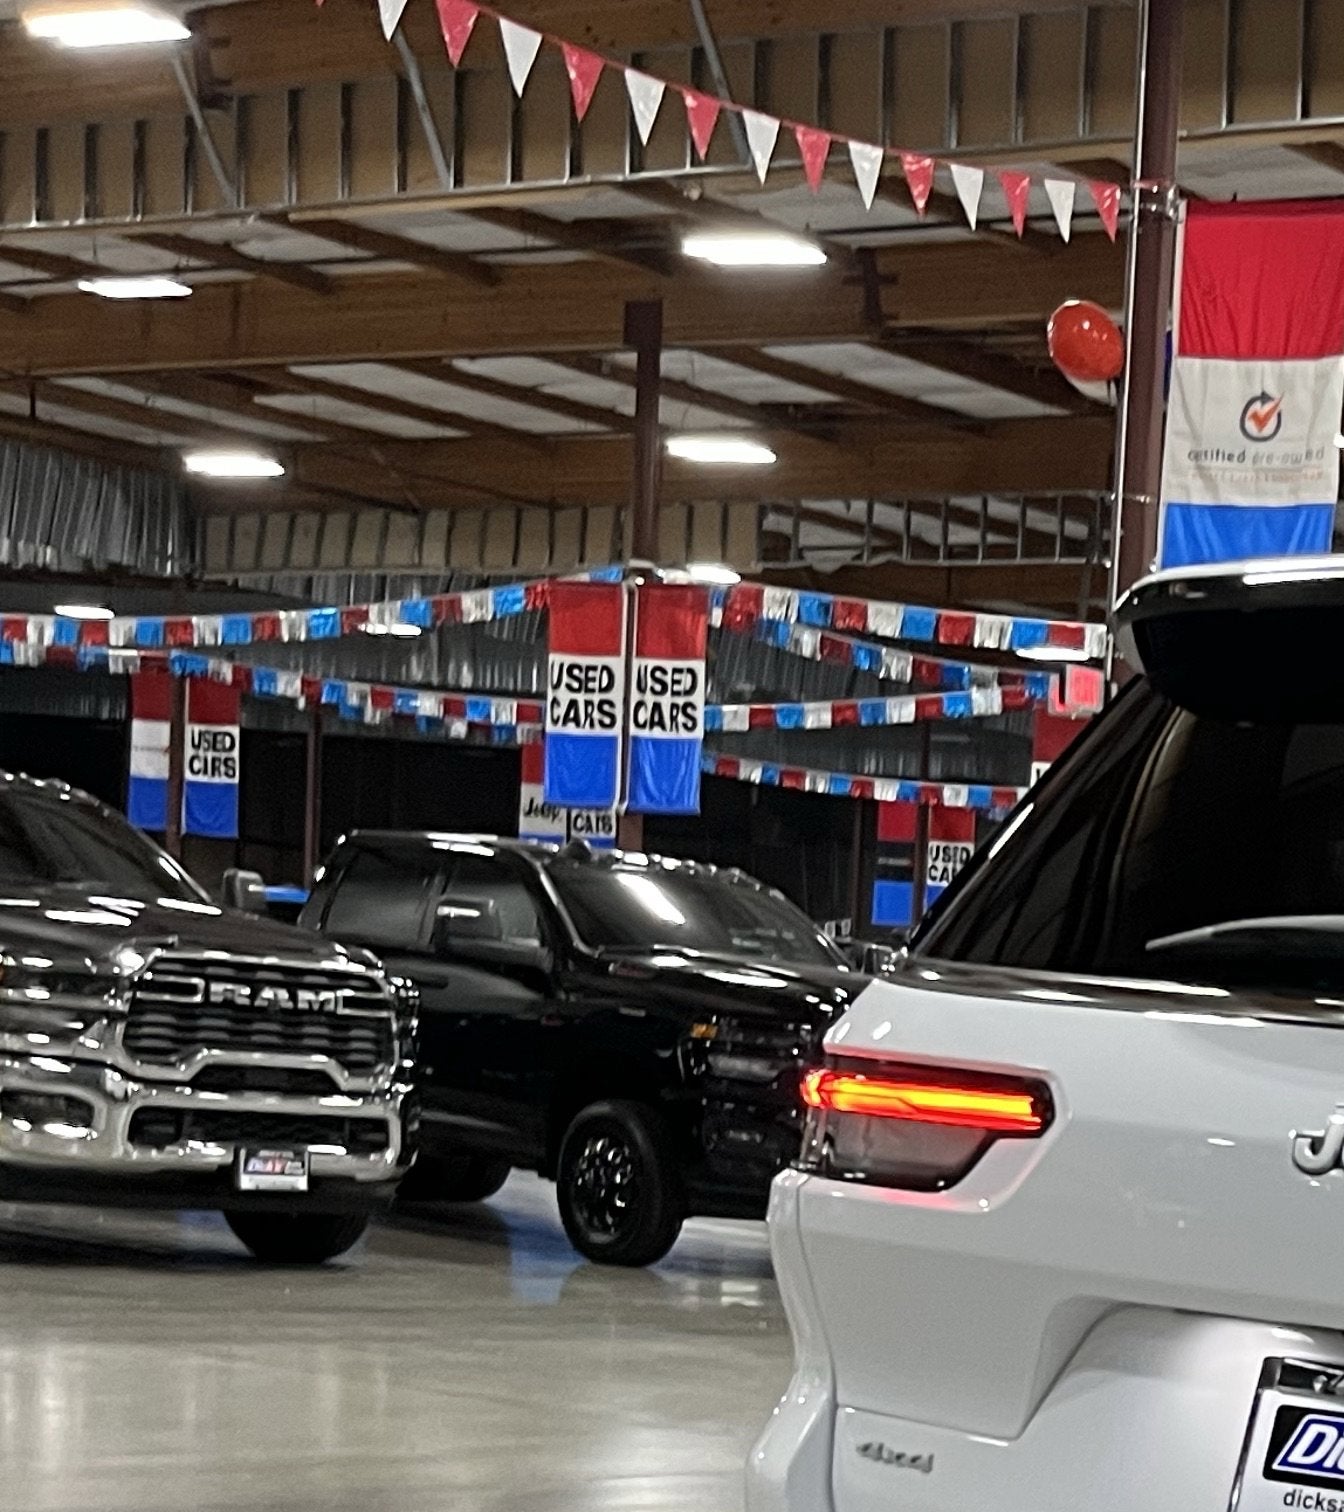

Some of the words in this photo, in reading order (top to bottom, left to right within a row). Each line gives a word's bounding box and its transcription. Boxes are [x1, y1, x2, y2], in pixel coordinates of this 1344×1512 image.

[1187, 448, 1247, 464] cetified
[550, 660, 616, 695] USED
[636, 664, 698, 697] USED
[549, 696, 617, 730] CARS
[632, 701, 698, 733] CARS
[191, 727, 236, 753] USED
[928, 865, 958, 883] CA
[209, 983, 336, 1012] RAM
